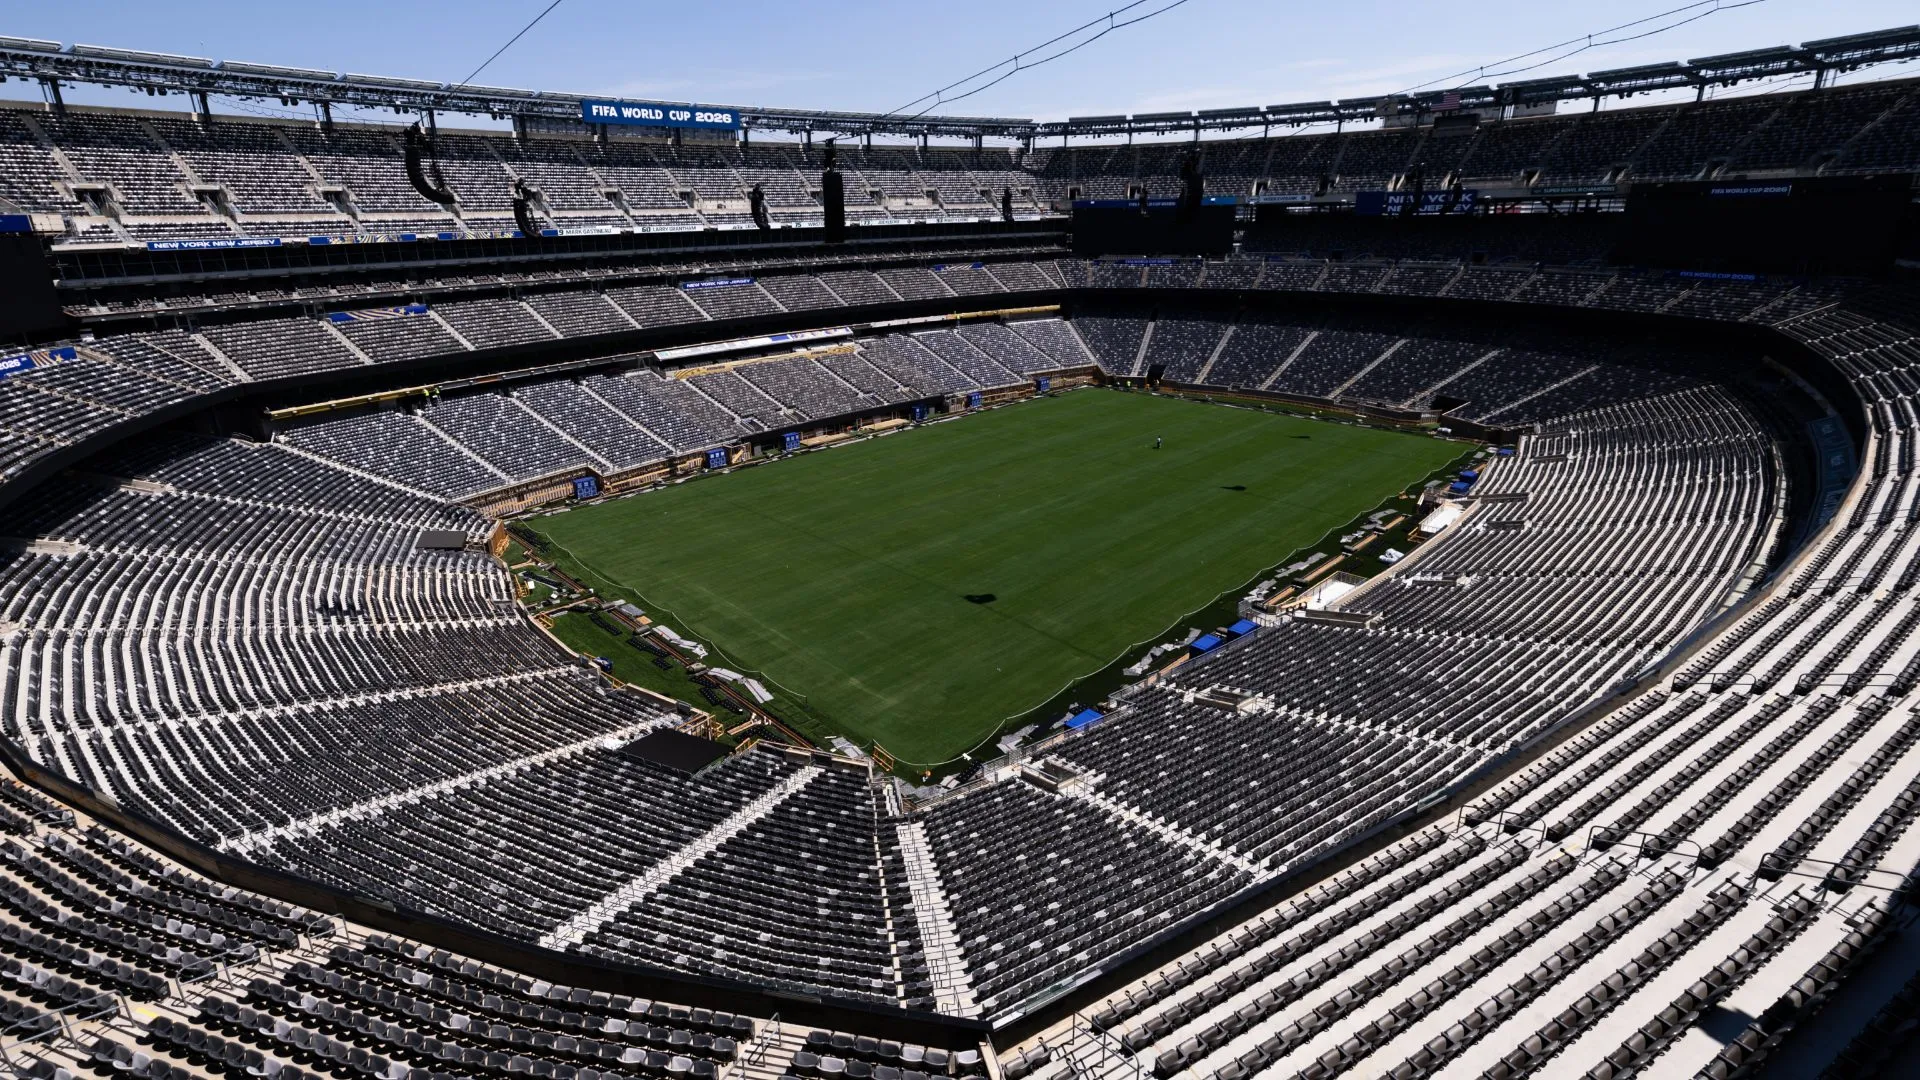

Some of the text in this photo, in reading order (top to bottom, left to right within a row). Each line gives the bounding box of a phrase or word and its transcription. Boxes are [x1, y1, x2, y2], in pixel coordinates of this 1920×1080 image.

[592, 105, 732, 123] FIFA WORLD CUP 2026
[1418, 204, 1471, 212] JEREY
